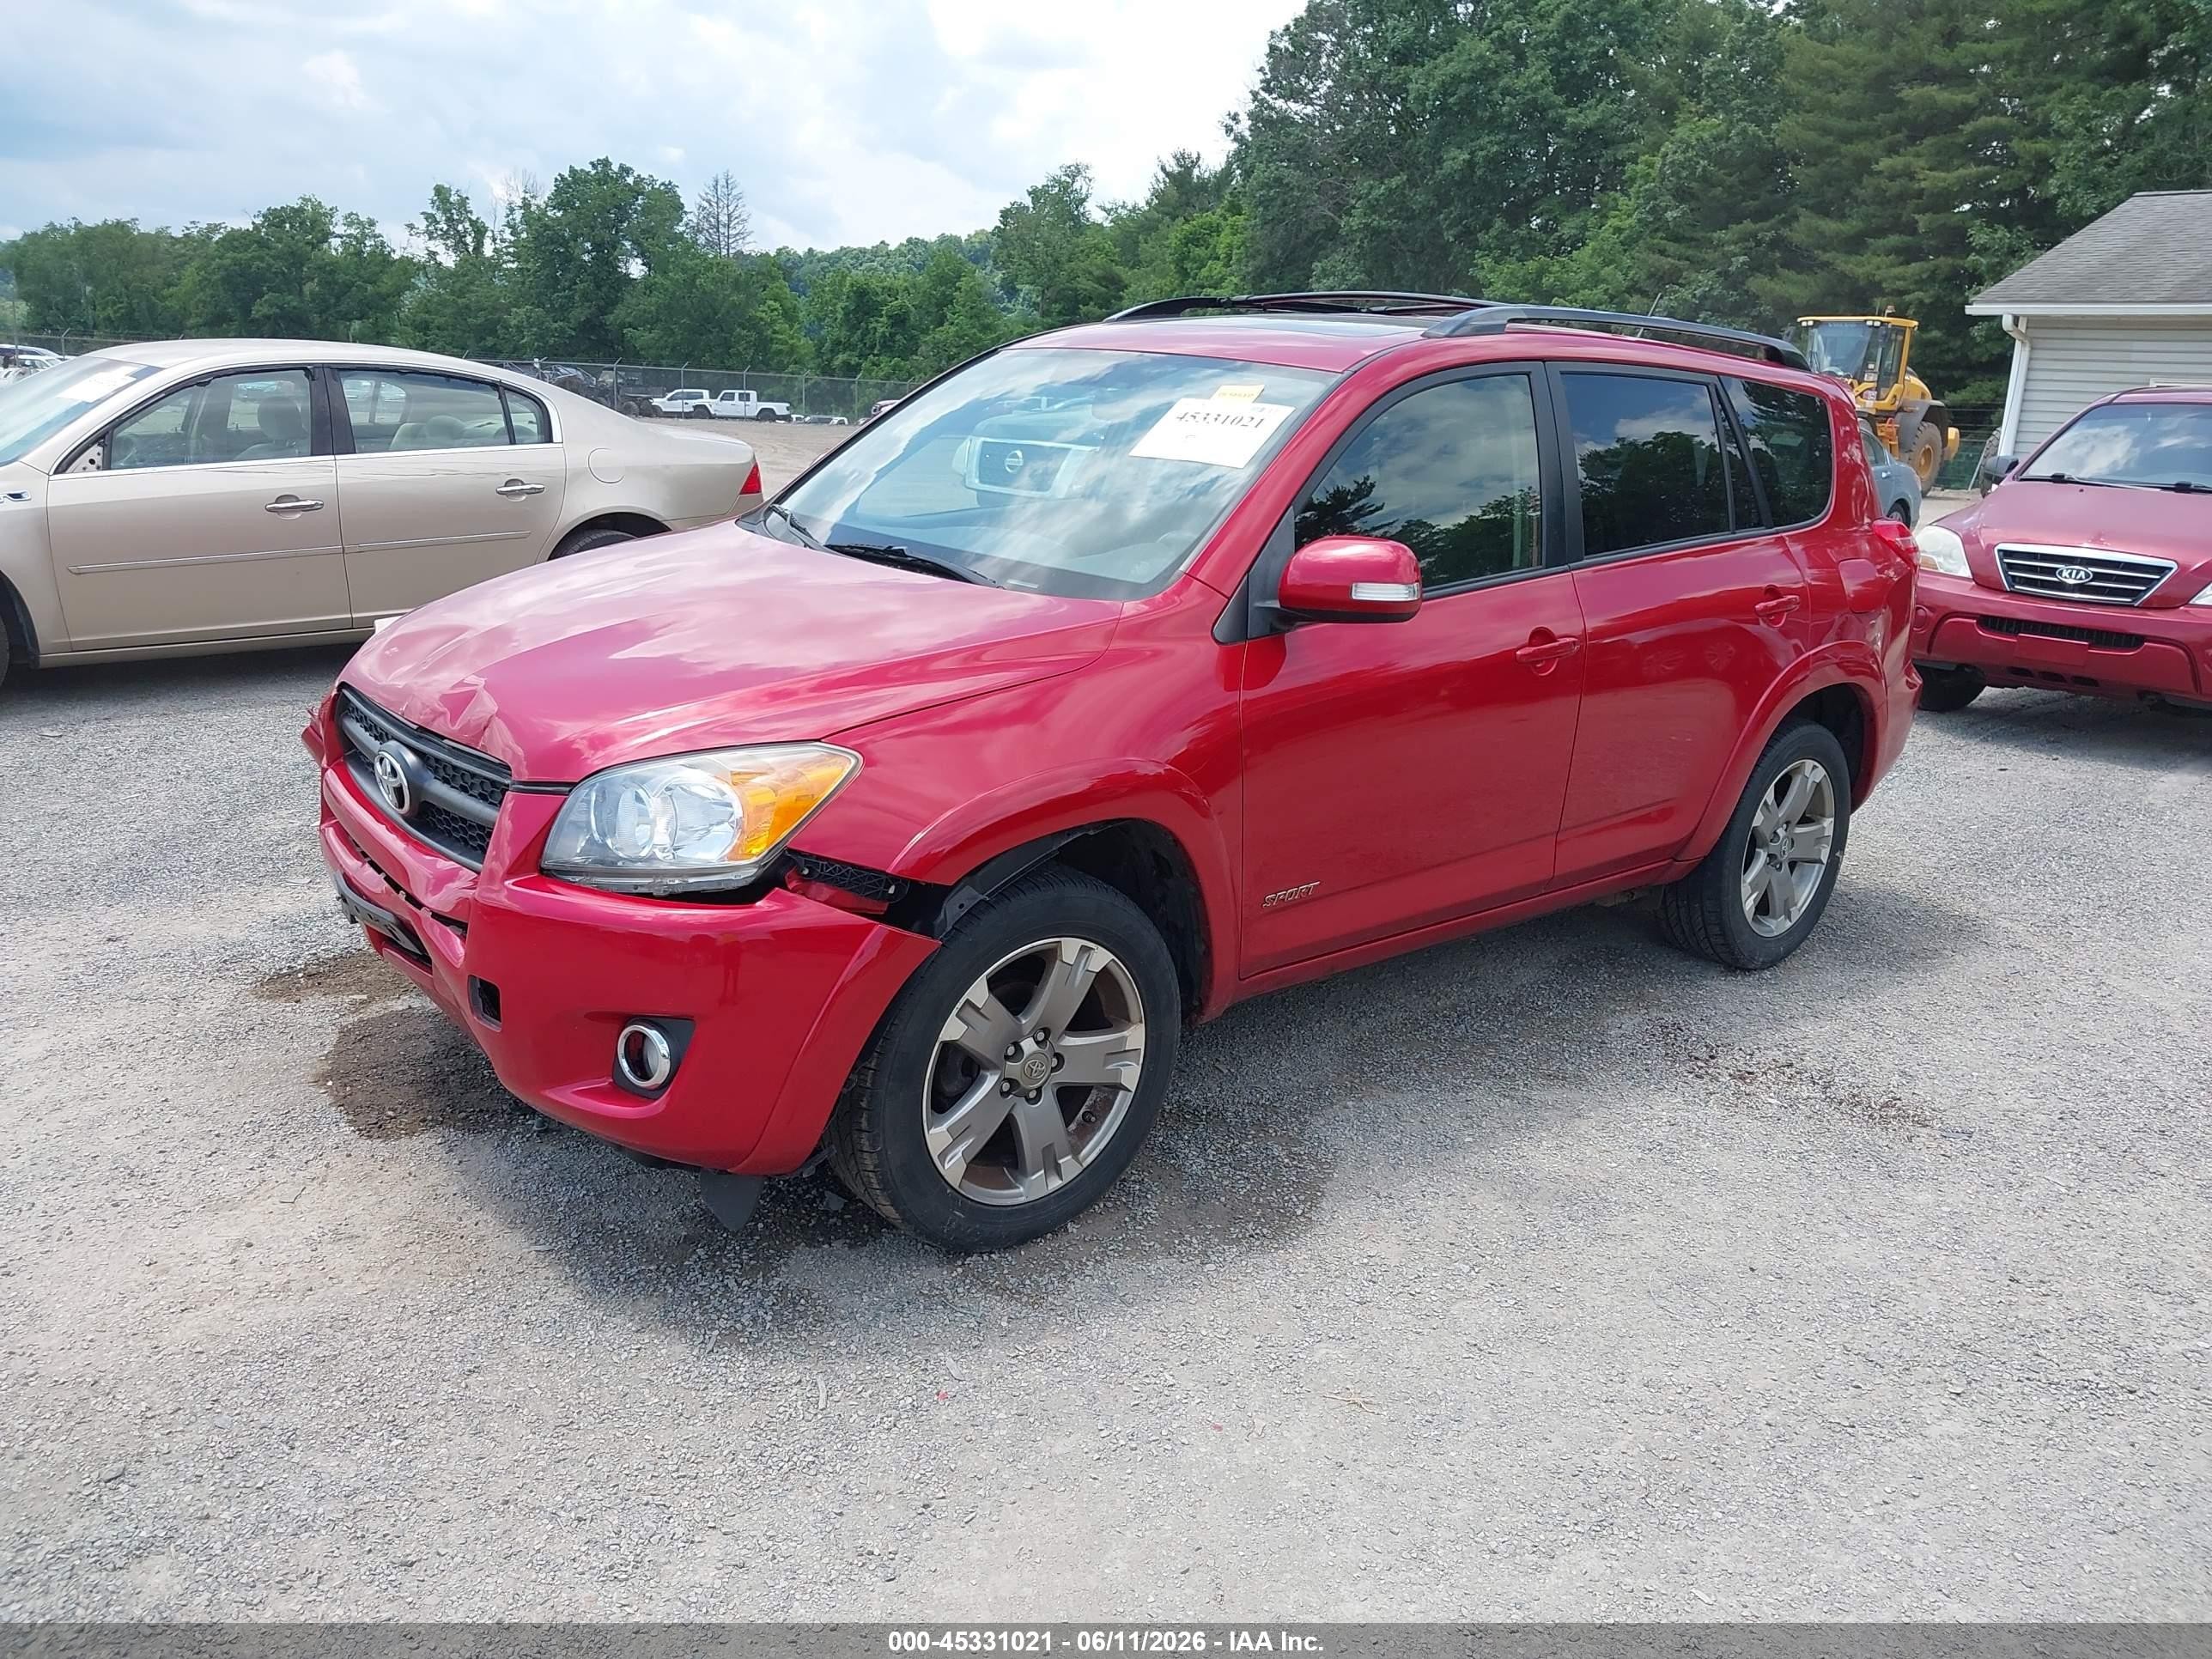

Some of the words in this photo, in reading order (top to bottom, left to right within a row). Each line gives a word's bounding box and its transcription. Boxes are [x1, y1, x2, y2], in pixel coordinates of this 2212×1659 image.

[1176, 411, 1266, 428] 45331021
[2062, 568, 2086, 580] KIA
[1261, 881, 1322, 908] SPORT
